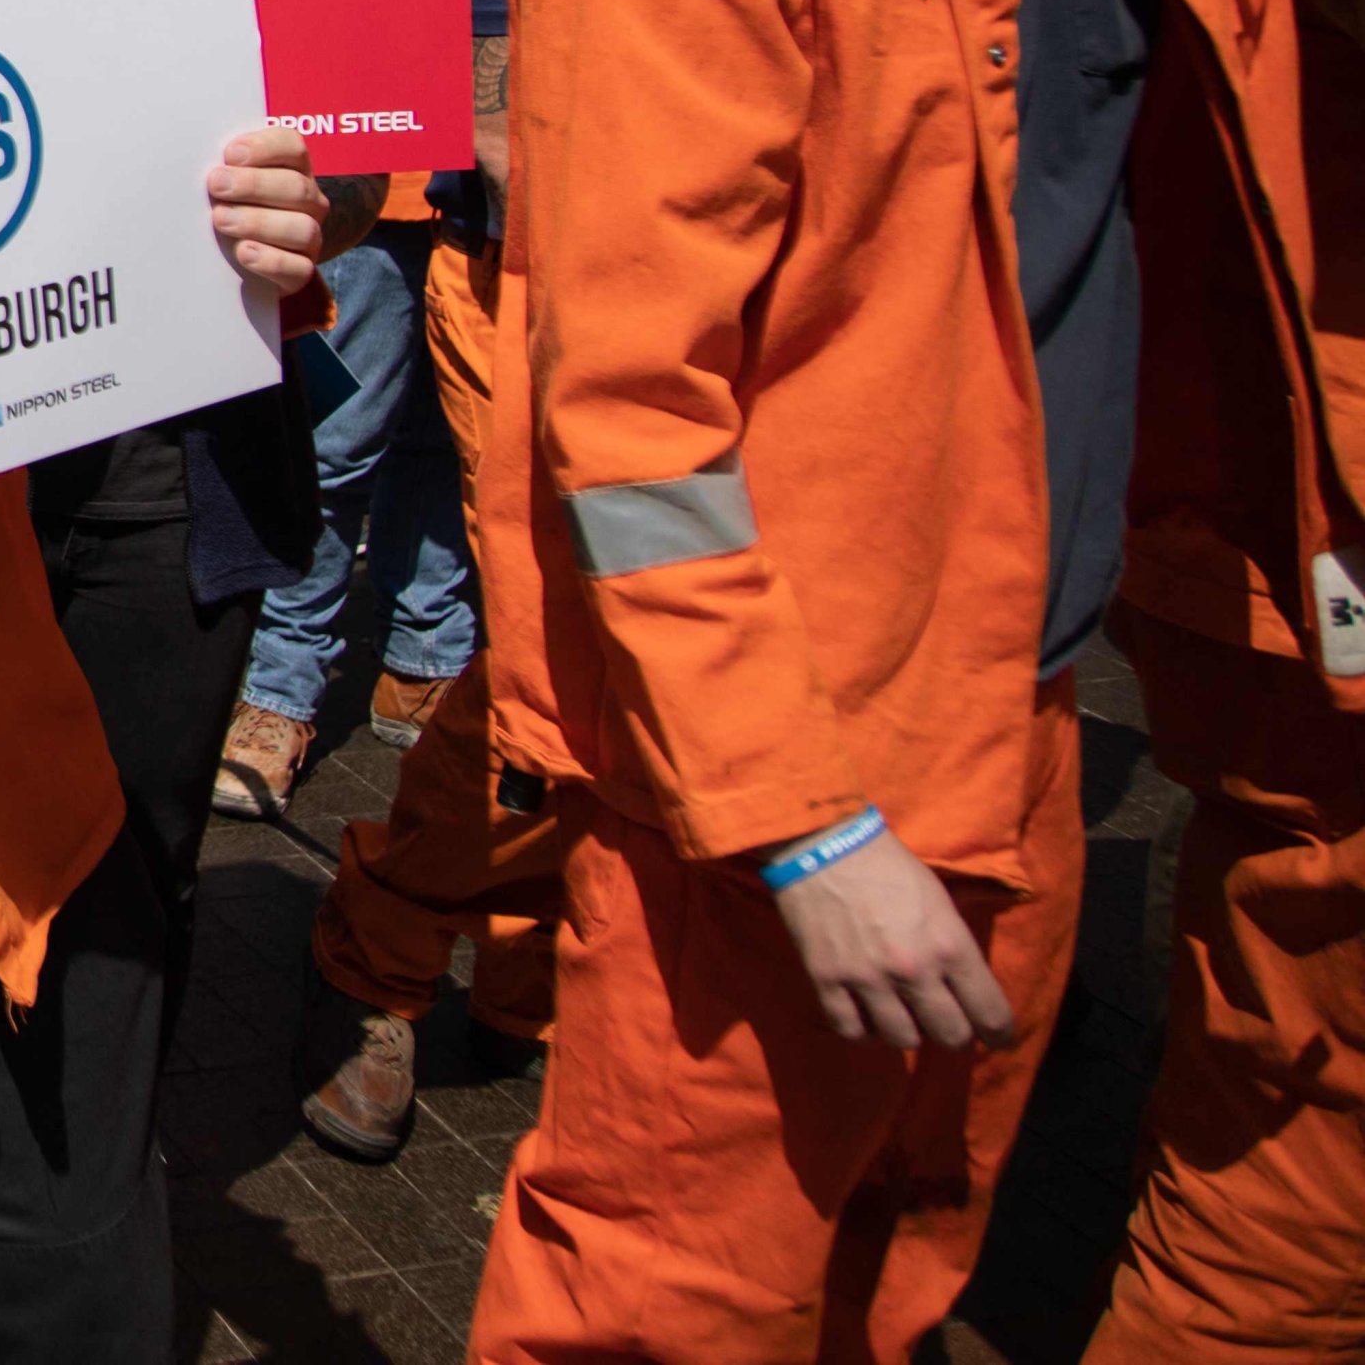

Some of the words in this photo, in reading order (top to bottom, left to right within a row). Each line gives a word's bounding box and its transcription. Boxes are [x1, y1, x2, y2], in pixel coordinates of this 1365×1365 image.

[340, 110, 424, 134] STEEL
[6, 388, 69, 421] NIPPON
[70, 372, 122, 401] STEEL
